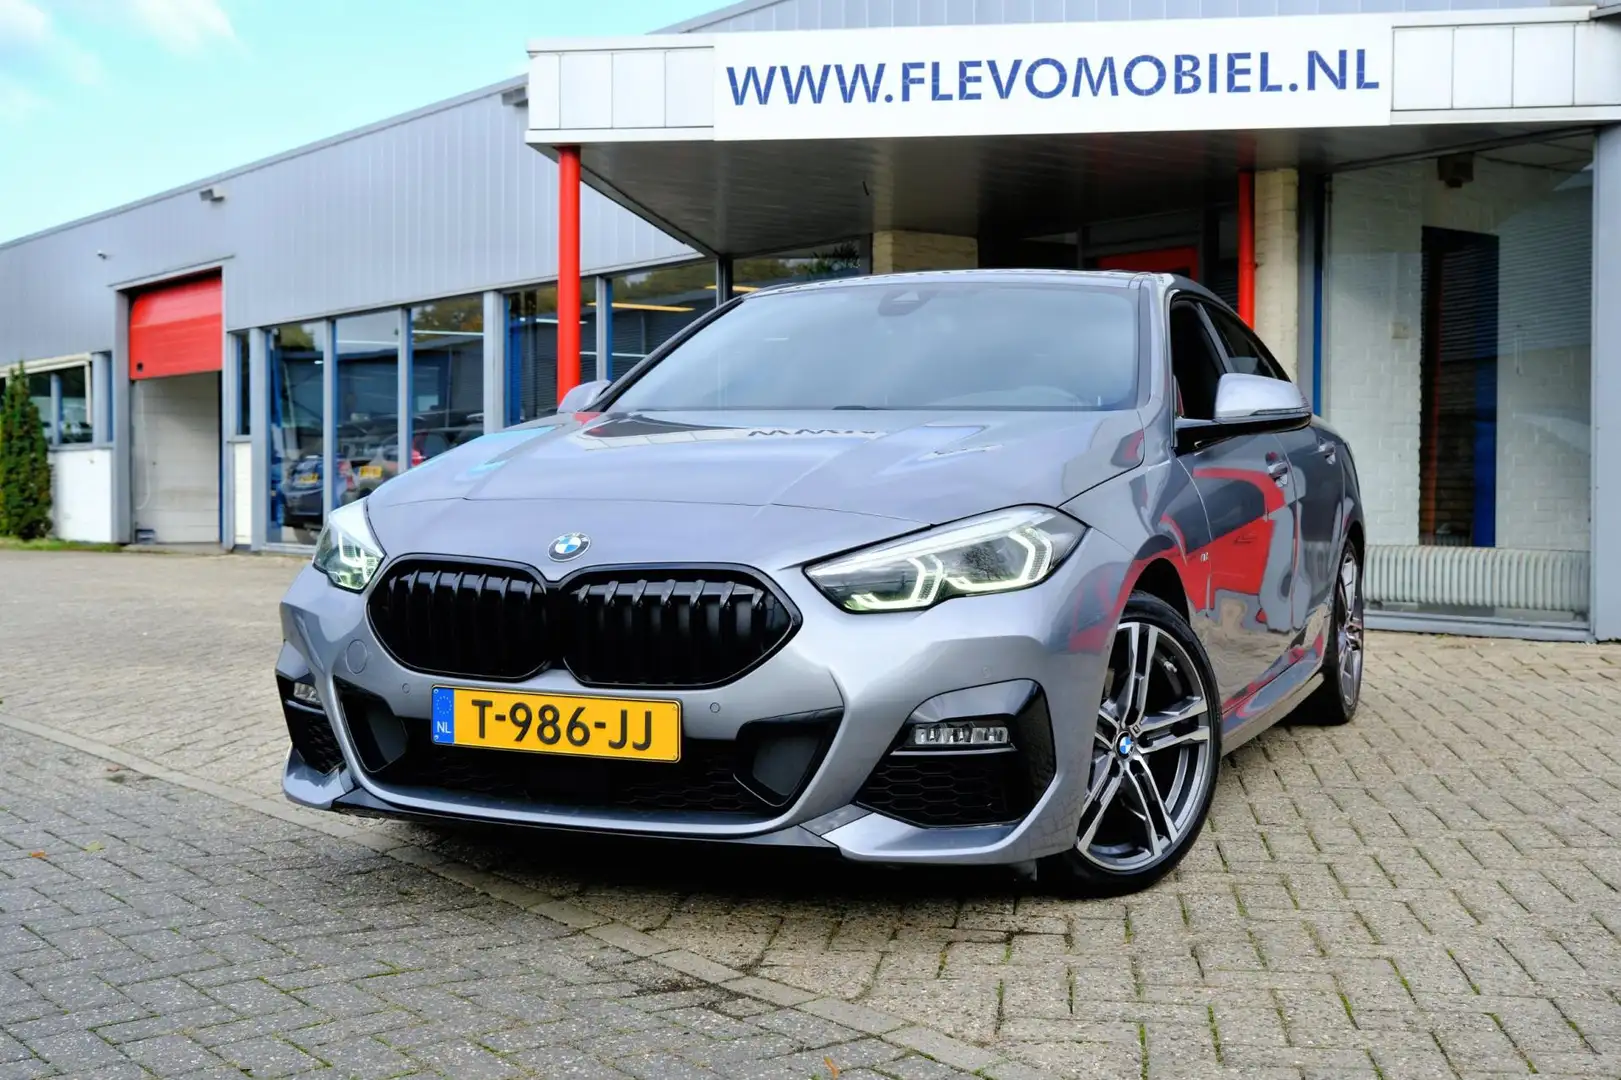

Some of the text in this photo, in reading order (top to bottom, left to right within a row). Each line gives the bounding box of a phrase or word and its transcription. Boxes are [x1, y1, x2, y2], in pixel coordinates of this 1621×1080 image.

[726, 49, 1380, 106] WWW.FLEVOMOBIEL.NL
[436, 720, 452, 734] NL
[471, 699, 652, 751] T-986-JJ
